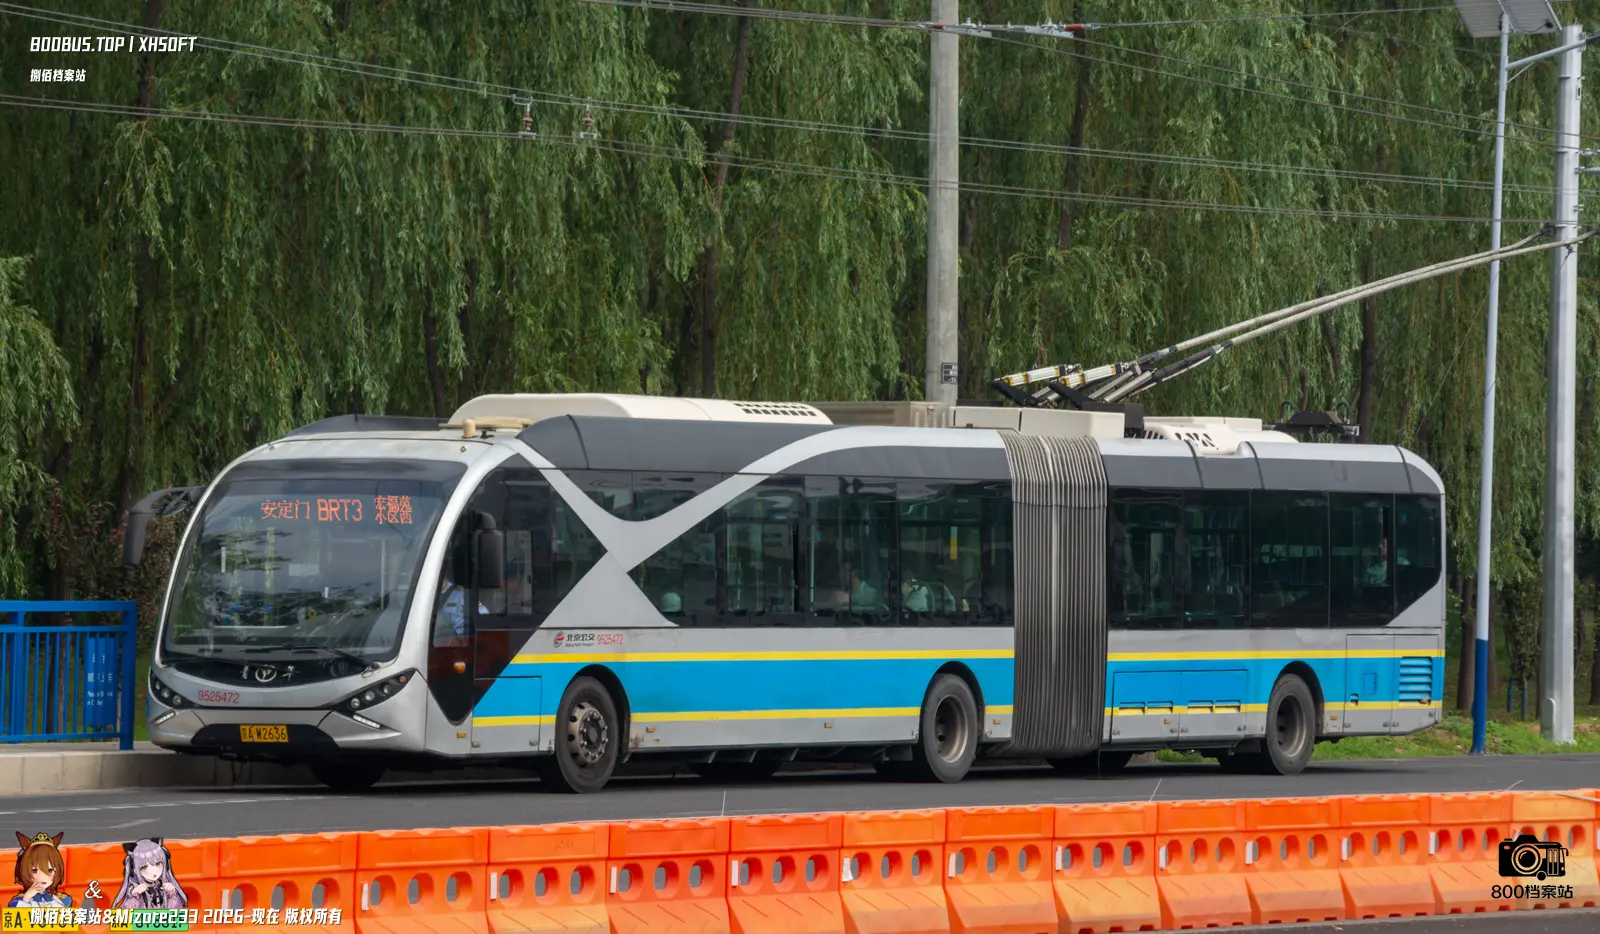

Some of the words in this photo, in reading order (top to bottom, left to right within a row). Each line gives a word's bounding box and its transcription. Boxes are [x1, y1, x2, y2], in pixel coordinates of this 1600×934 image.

[260, 499, 311, 520] 安定门
[317, 498, 363, 522] BRT3
[566, 633, 595, 642] 北京公交
[198, 690, 240, 704] 9525472
